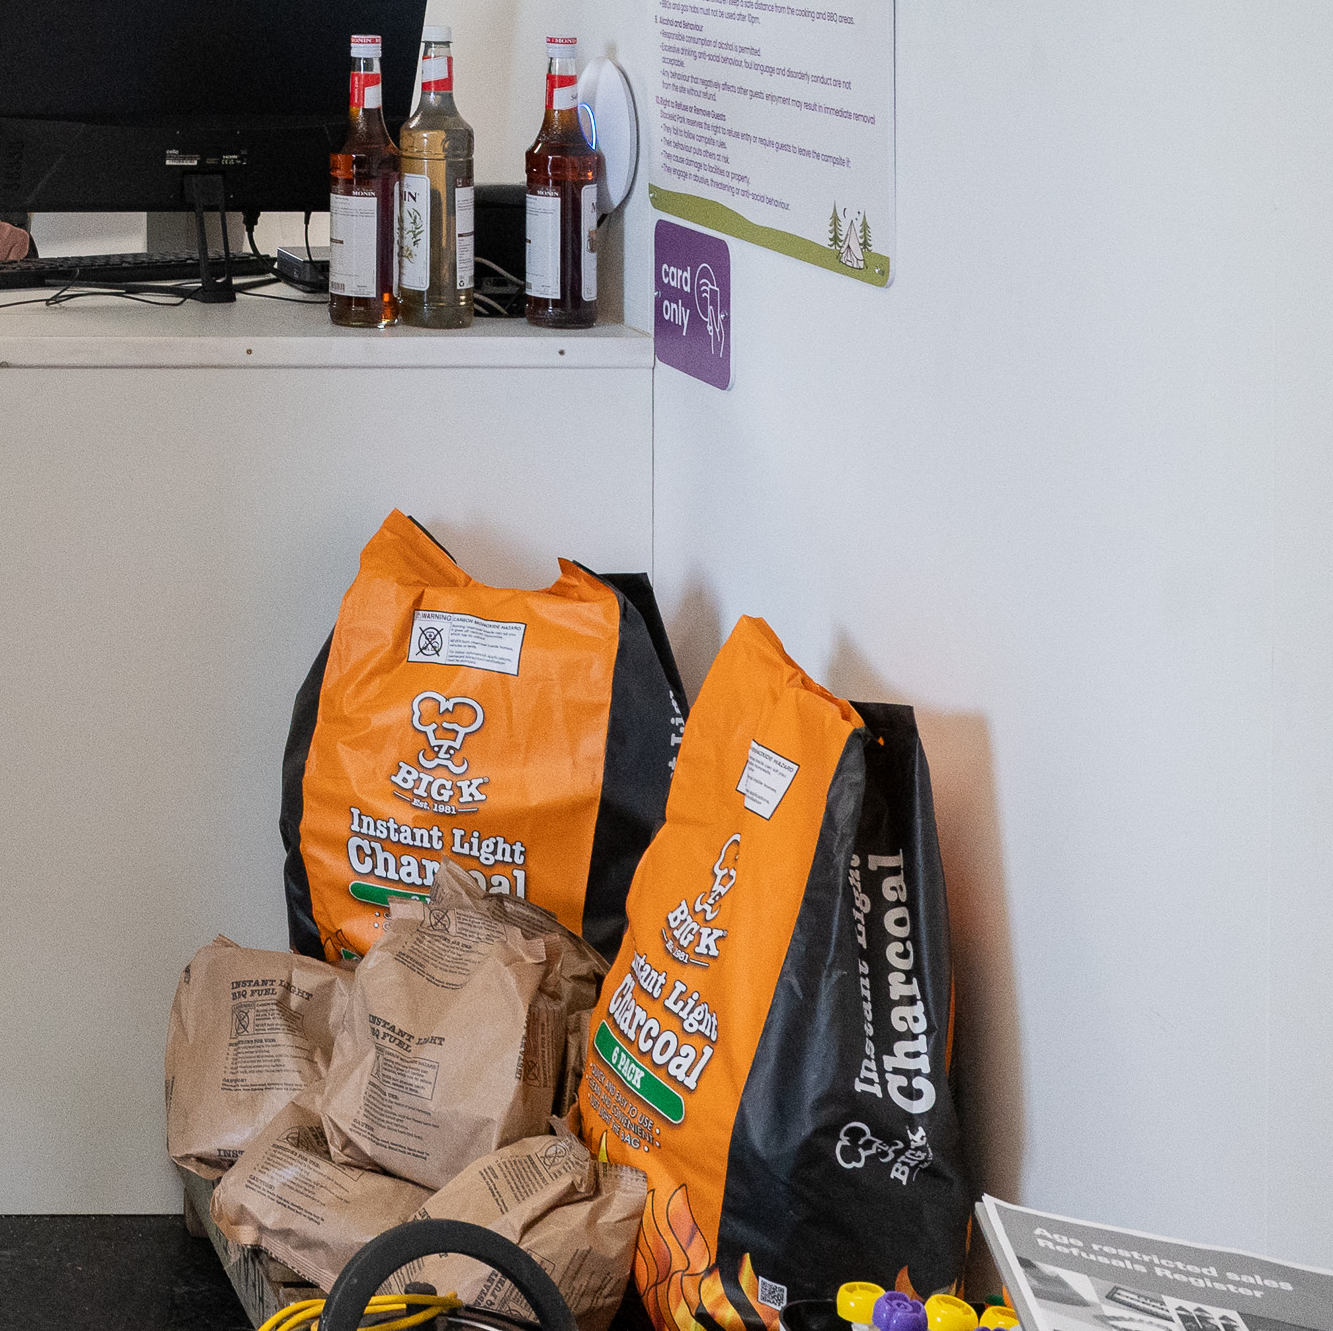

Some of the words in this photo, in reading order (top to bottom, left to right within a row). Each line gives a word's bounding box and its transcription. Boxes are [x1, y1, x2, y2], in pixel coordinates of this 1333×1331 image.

[660, 110, 676, 122] Stockeld
[676, 114, 685, 124] Park
[686, 117, 702, 129] reserves
[711, 123, 721, 137] right
[721, 126, 726, 135] to
[727, 127, 739, 139] refuse
[740, 131, 751, 145] entry
[758, 135, 774, 151] require
[775, 140, 791, 156] guests
[791, 144, 797, 154] to
[797, 145, 811, 158] leave
[811, 149, 820, 160] the
[821, 151, 845, 169] campsite
[661, 260, 691, 293] card
[662, 297, 690, 335] only
[421, 612, 452, 621] WARNING
[453, 616, 473, 624] CARBON
[474, 620, 501, 630] MONOXIDE
[390, 761, 454, 802] BIG
[456, 777, 487, 803] K
[411, 798, 430, 810] Est.
[433, 803, 457, 815] 1981
[350, 807, 443, 850] Instant
[451, 827, 526, 866] Light
[347, 836, 526, 900] Charoal
[667, 899, 700, 948] BIG
[694, 927, 724, 957] K
[673, 948, 689, 963] 1981
[231, 979, 277, 990] INSTANT
[278, 979, 314, 1002] LIGHT
[231, 990, 248, 1001] BBQ
[249, 988, 278, 998] FUEL
[868, 848, 936, 1114] Charcoal
[664, 979, 718, 1042] Light
[854, 958, 882, 1098] Instant
[381, 1031, 412, 1053] FUEL
[609, 973, 714, 1091] Charcoal
[611, 1046, 619, 1065] 6
[617, 1051, 645, 1090] PACK
[611, 1103, 654, 1145] CONVENIENT
[614, 1090, 628, 1110] EASY
[627, 1103, 638, 1118] TO
[638, 1113, 654, 1131] USE
[620, 1130, 641, 1149] BAG
[906, 1125, 927, 1143] K
[890, 1144, 927, 1186] BIG
[1033, 1227, 1084, 1248] Age
[1091, 1243, 1218, 1277] restricted
[1226, 1269, 1294, 1292] sales
[1036, 1238, 1148, 1273] Refusals
[1155, 1268, 1264, 1299] Register
